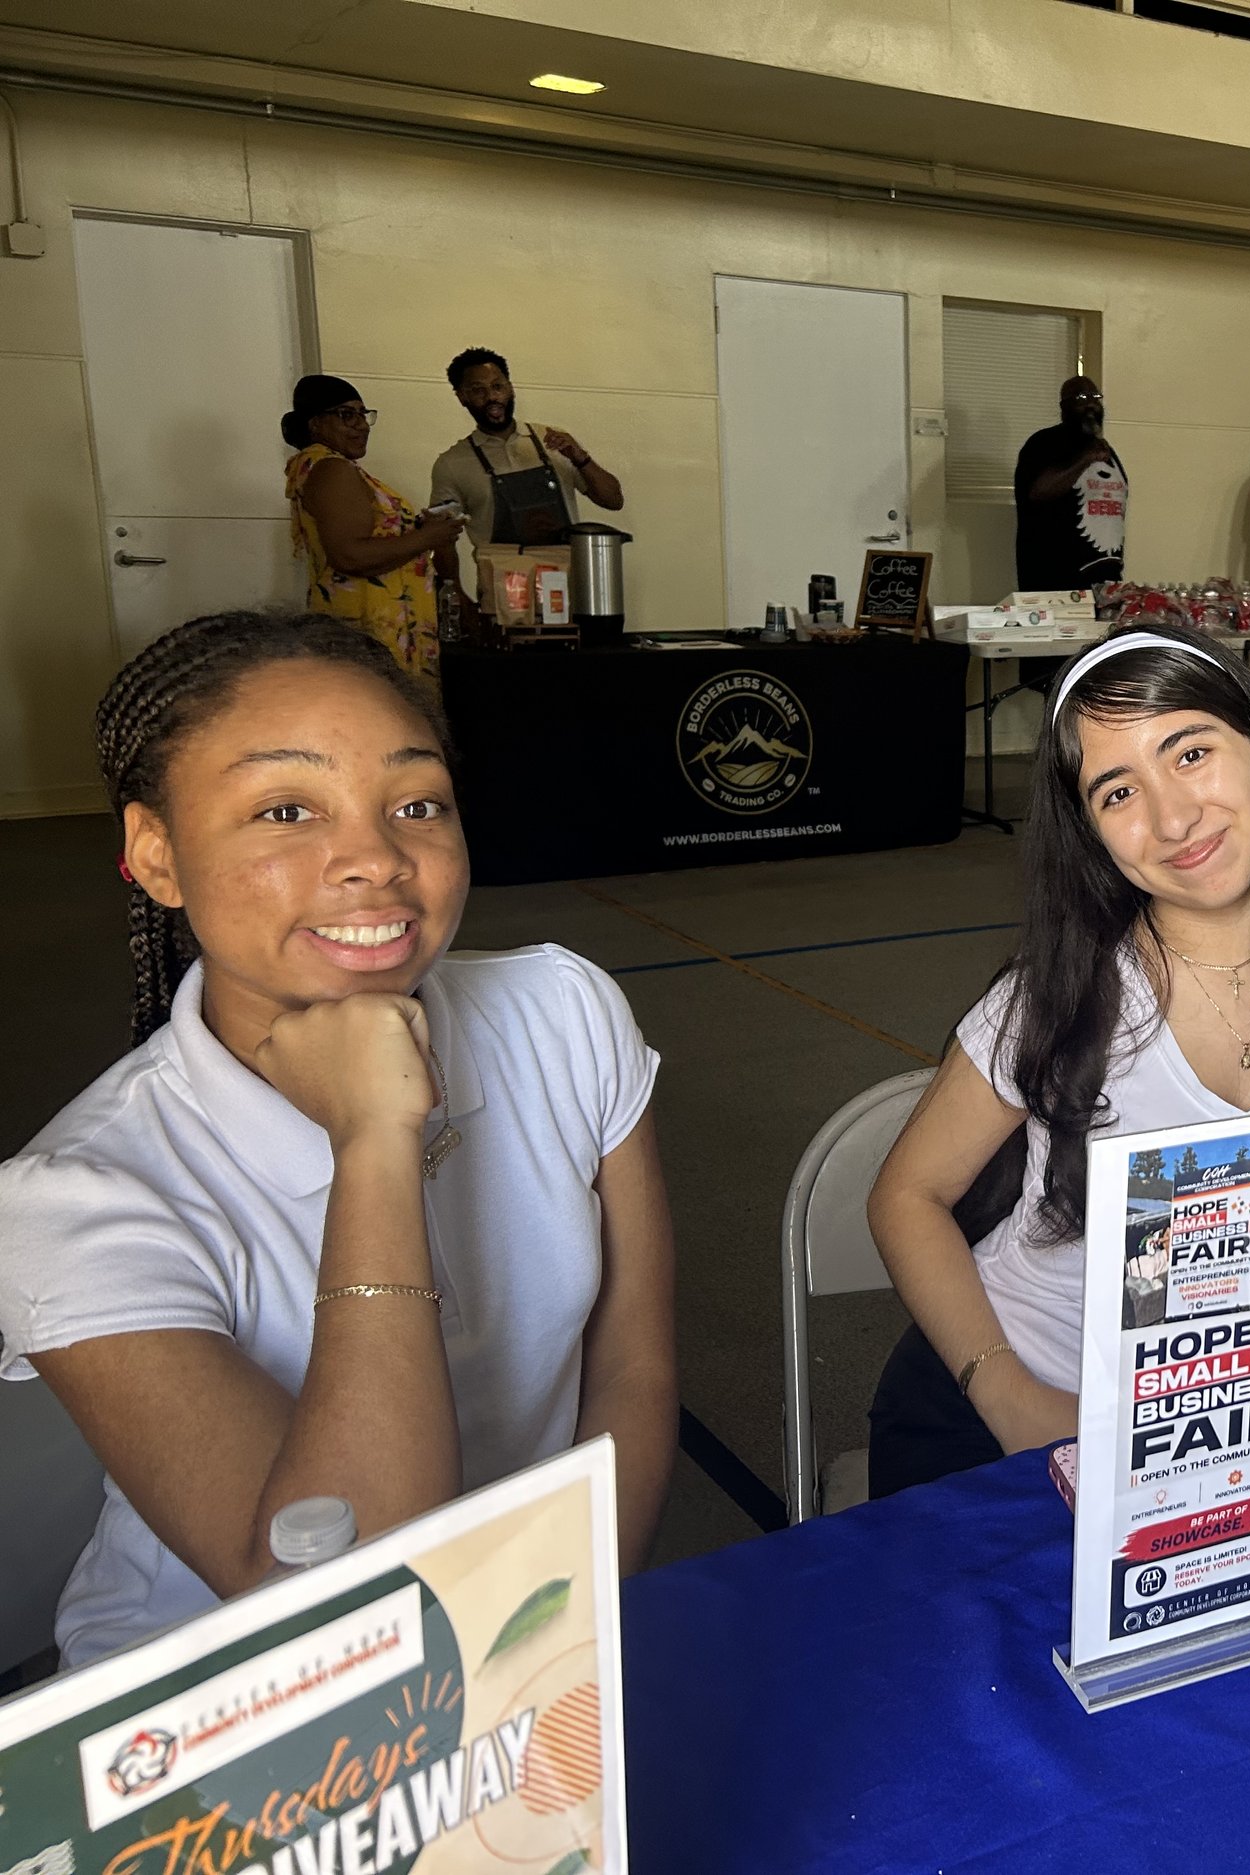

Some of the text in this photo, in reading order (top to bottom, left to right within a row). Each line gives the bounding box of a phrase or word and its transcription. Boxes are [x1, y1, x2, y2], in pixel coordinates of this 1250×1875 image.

[871, 556, 918, 576] Coffee
[868, 578, 916, 598] Coffee
[687, 677, 800, 733] BORDERLESS BEANS
[719, 789, 784, 806] TRADING CO.
[808, 787, 820, 795] TM
[663, 824, 842, 845] WWW.BORDERLESSBEANS.COM
[1202, 1165, 1232, 1181] COH
[1177, 1180, 1211, 1192] COMMUNITY
[1194, 1181, 1236, 1193] CORPORATION
[1174, 1198, 1228, 1219] HOPE
[1173, 1213, 1225, 1232] SMALL
[1172, 1221, 1247, 1245] BUSINESS
[1171, 1236, 1250, 1267] FAIR
[1170, 1266, 1188, 1275] OPEN
[1200, 1262, 1211, 1270] THE
[1172, 1267, 1249, 1286] ENTREPRENEURS
[1179, 1278, 1239, 1292] INNOVATORS
[1181, 1287, 1238, 1301] VISIONARIES
[1138, 1354, 1249, 1397] SMALL
[1141, 1467, 1169, 1482] OPEN
[1173, 1464, 1186, 1474] TO
[1190, 1458, 1210, 1470] THE
[1132, 1502, 1187, 1521] ENTREPRENEURS
[1191, 1516, 1205, 1527] BE
[1206, 1509, 1232, 1523] PART
[1234, 1505, 1248, 1515] OF
[1151, 1517, 1244, 1552] SHOWCASE.
[1175, 1558, 1202, 1571] SPACE
[1214, 1546, 1247, 1560] LIMITED!
[1174, 1566, 1210, 1580] RESERVE
[1212, 1561, 1234, 1571] YOUR
[1175, 1576, 1204, 1589] TODAY.
[1169, 1594, 1209, 1612] CENTER
[1218, 1588, 1228, 1596] OF
[1169, 1605, 1195, 1619] COMMUNITY
[1196, 1596, 1229, 1611] DEVELOPMENT
